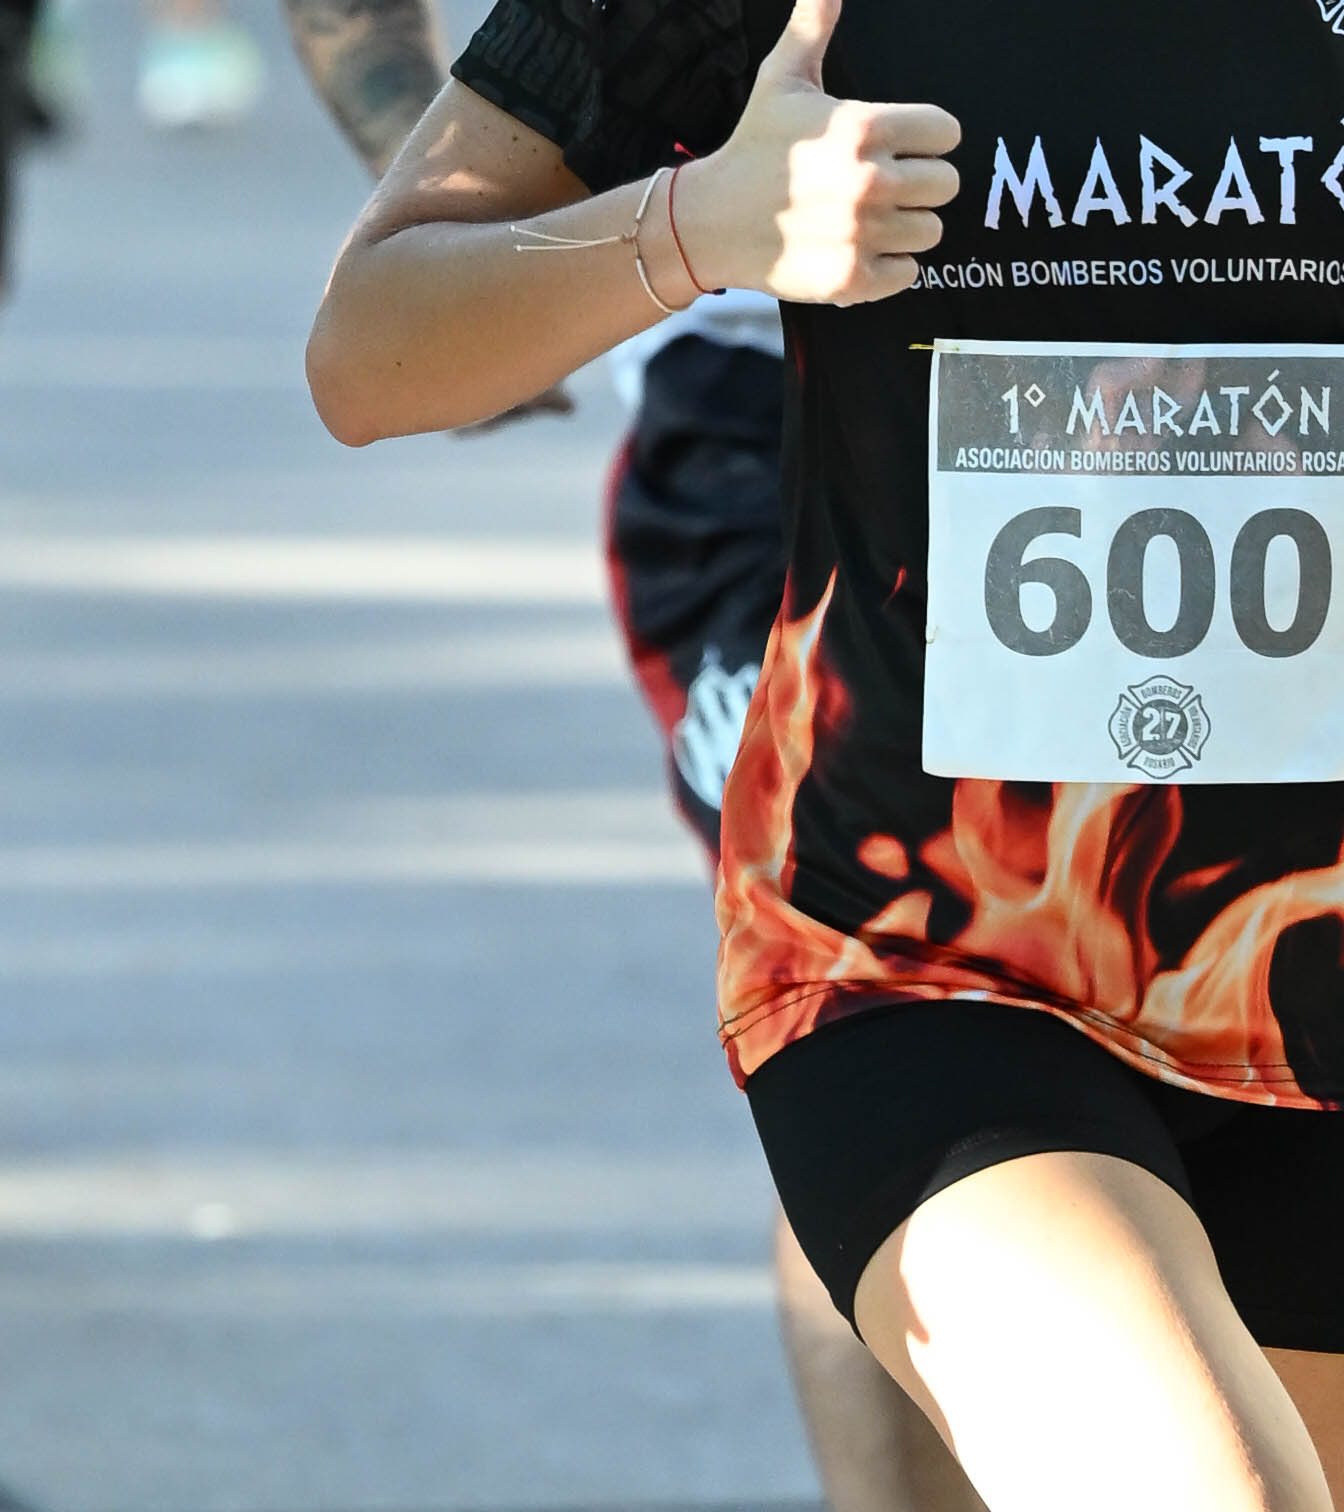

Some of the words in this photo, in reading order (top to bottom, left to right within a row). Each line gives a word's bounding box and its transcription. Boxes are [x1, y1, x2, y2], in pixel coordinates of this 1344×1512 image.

[1013, 259, 1164, 288] BOMBEROS
[1170, 257, 1344, 287] VOLUNTARIO
[1065, 369, 1330, 437] MARATÓN
[955, 445, 1065, 470] ASOCIACIÓN
[1070, 447, 1171, 472] BOMBEROS
[1175, 449, 1296, 473] VOLUNTARIOS
[984, 506, 1332, 658] 600
[1143, 707, 1181, 741] 27
